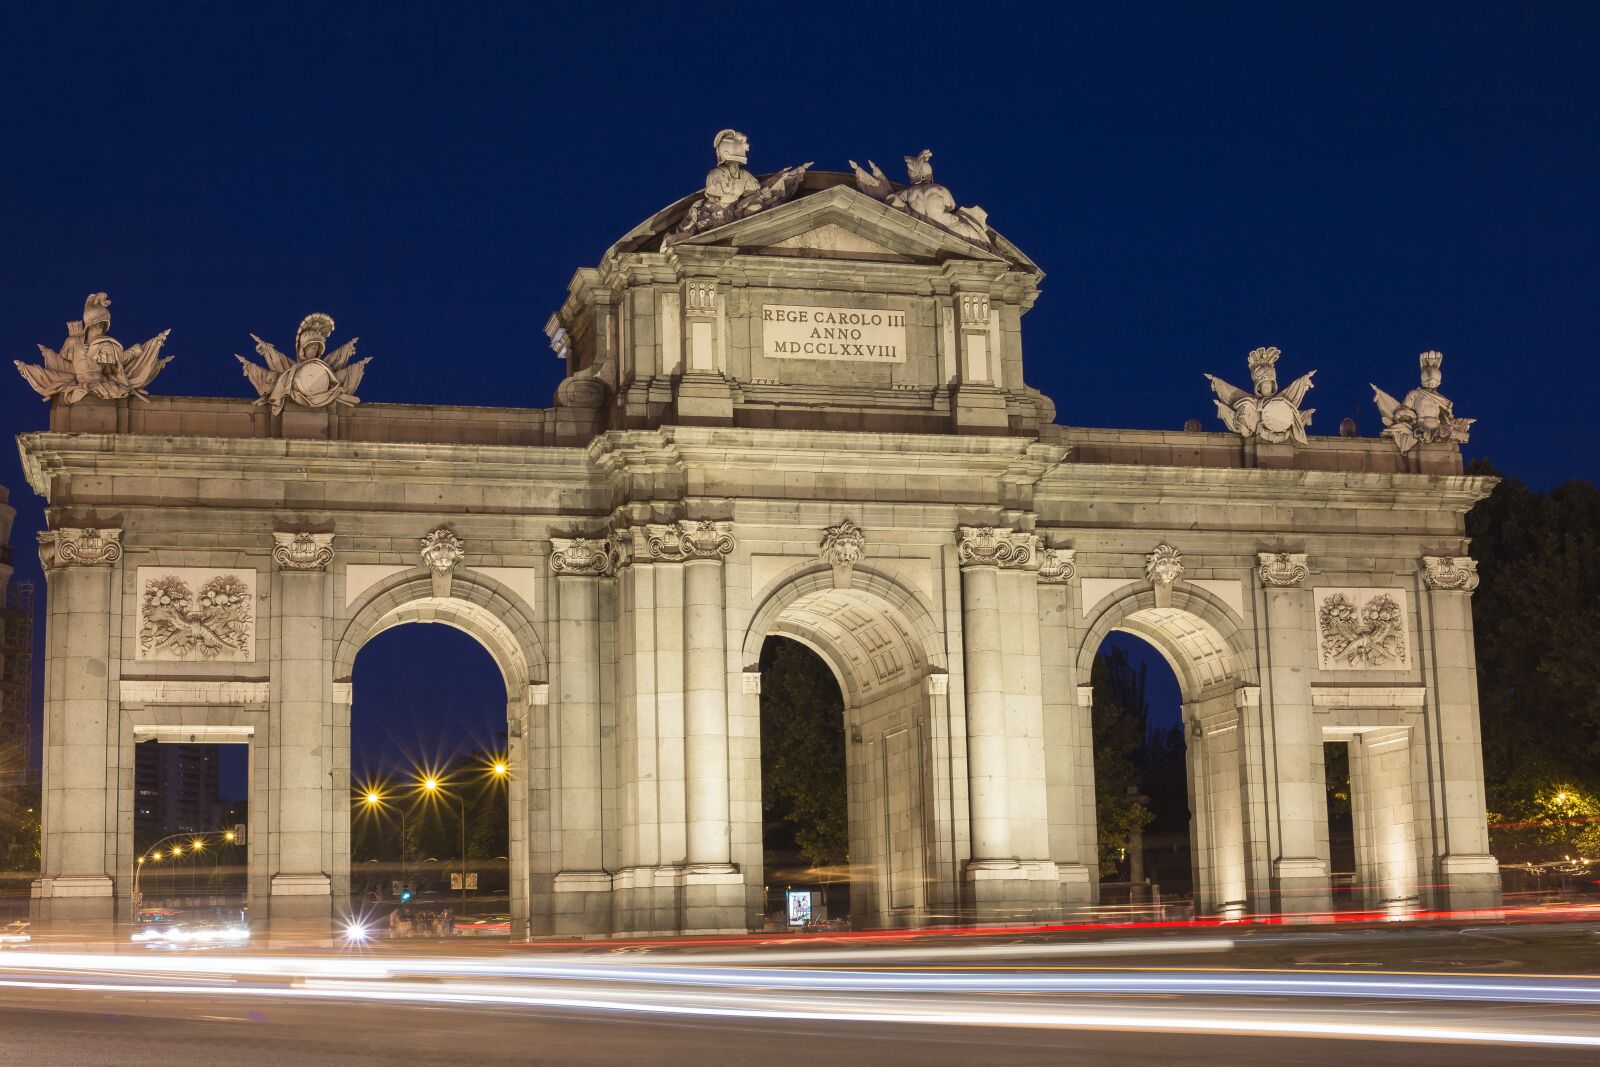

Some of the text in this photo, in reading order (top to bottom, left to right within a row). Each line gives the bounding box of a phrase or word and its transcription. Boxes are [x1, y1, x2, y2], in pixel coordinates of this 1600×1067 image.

[763, 310, 905, 327] REGE CAROLO III
[810, 327, 861, 340] ANNO
[774, 341, 897, 357] MDCCLXXVIII
